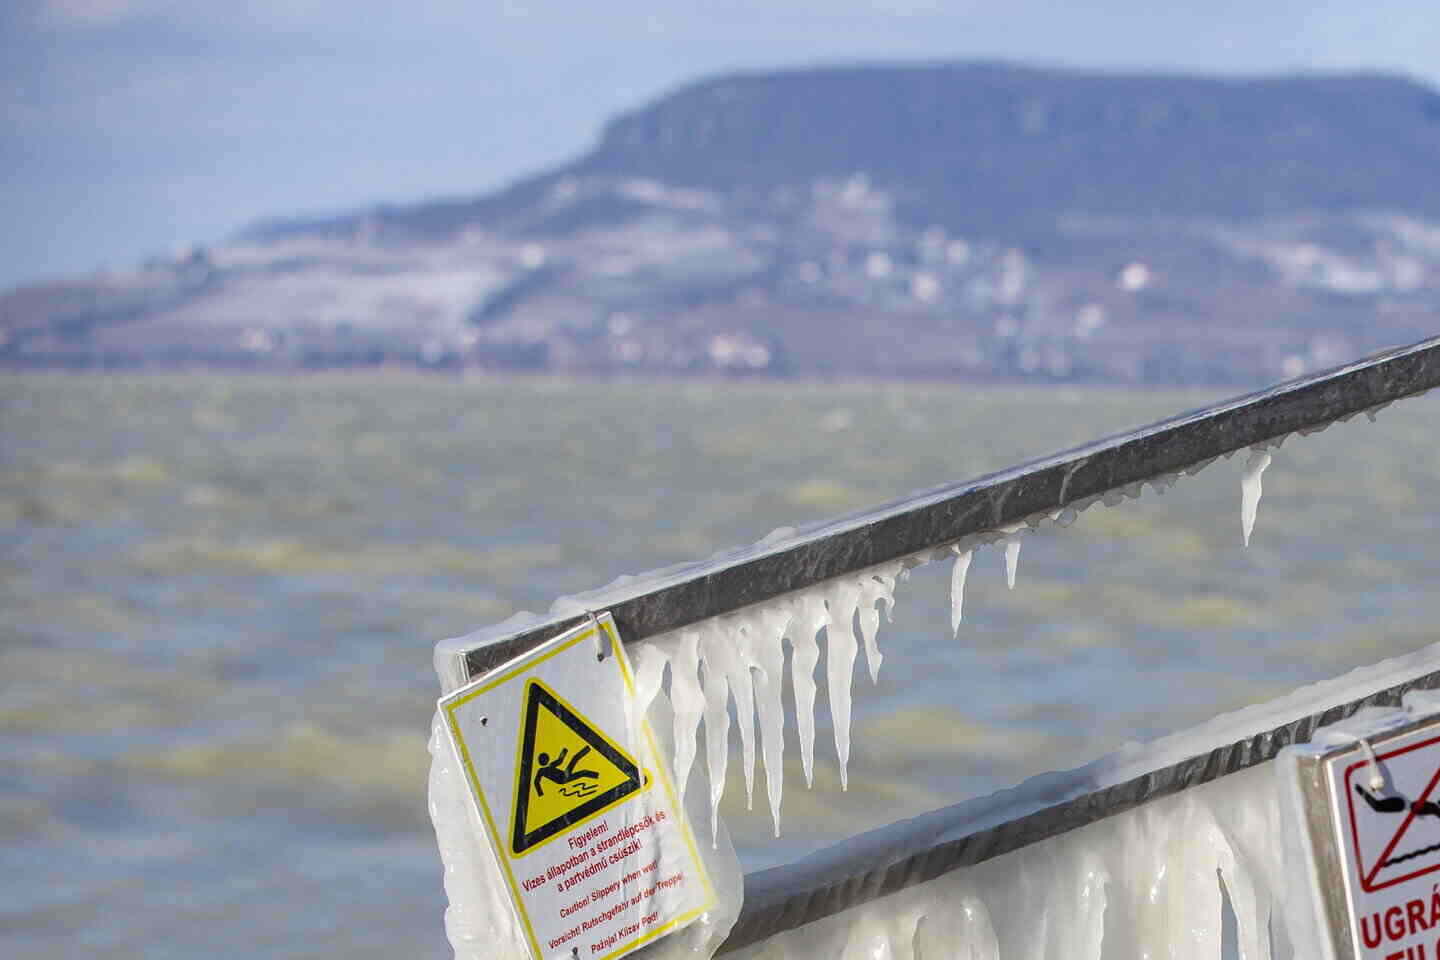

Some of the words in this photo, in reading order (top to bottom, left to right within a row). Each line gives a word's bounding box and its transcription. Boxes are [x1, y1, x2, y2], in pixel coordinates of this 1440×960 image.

[568, 819, 608, 850] Figyelem!
[522, 874, 546, 892] Vizes
[546, 850, 590, 882] állapotban
[590, 848, 596, 857] a
[557, 883, 564, 892] a
[560, 896, 590, 919] Caution!
[591, 880, 620, 902] Slippery
[622, 870, 641, 885] when
[548, 925, 580, 949] Vorsicht!
[582, 902, 629, 932] Rutschgefahr
[630, 890, 642, 906] auf
